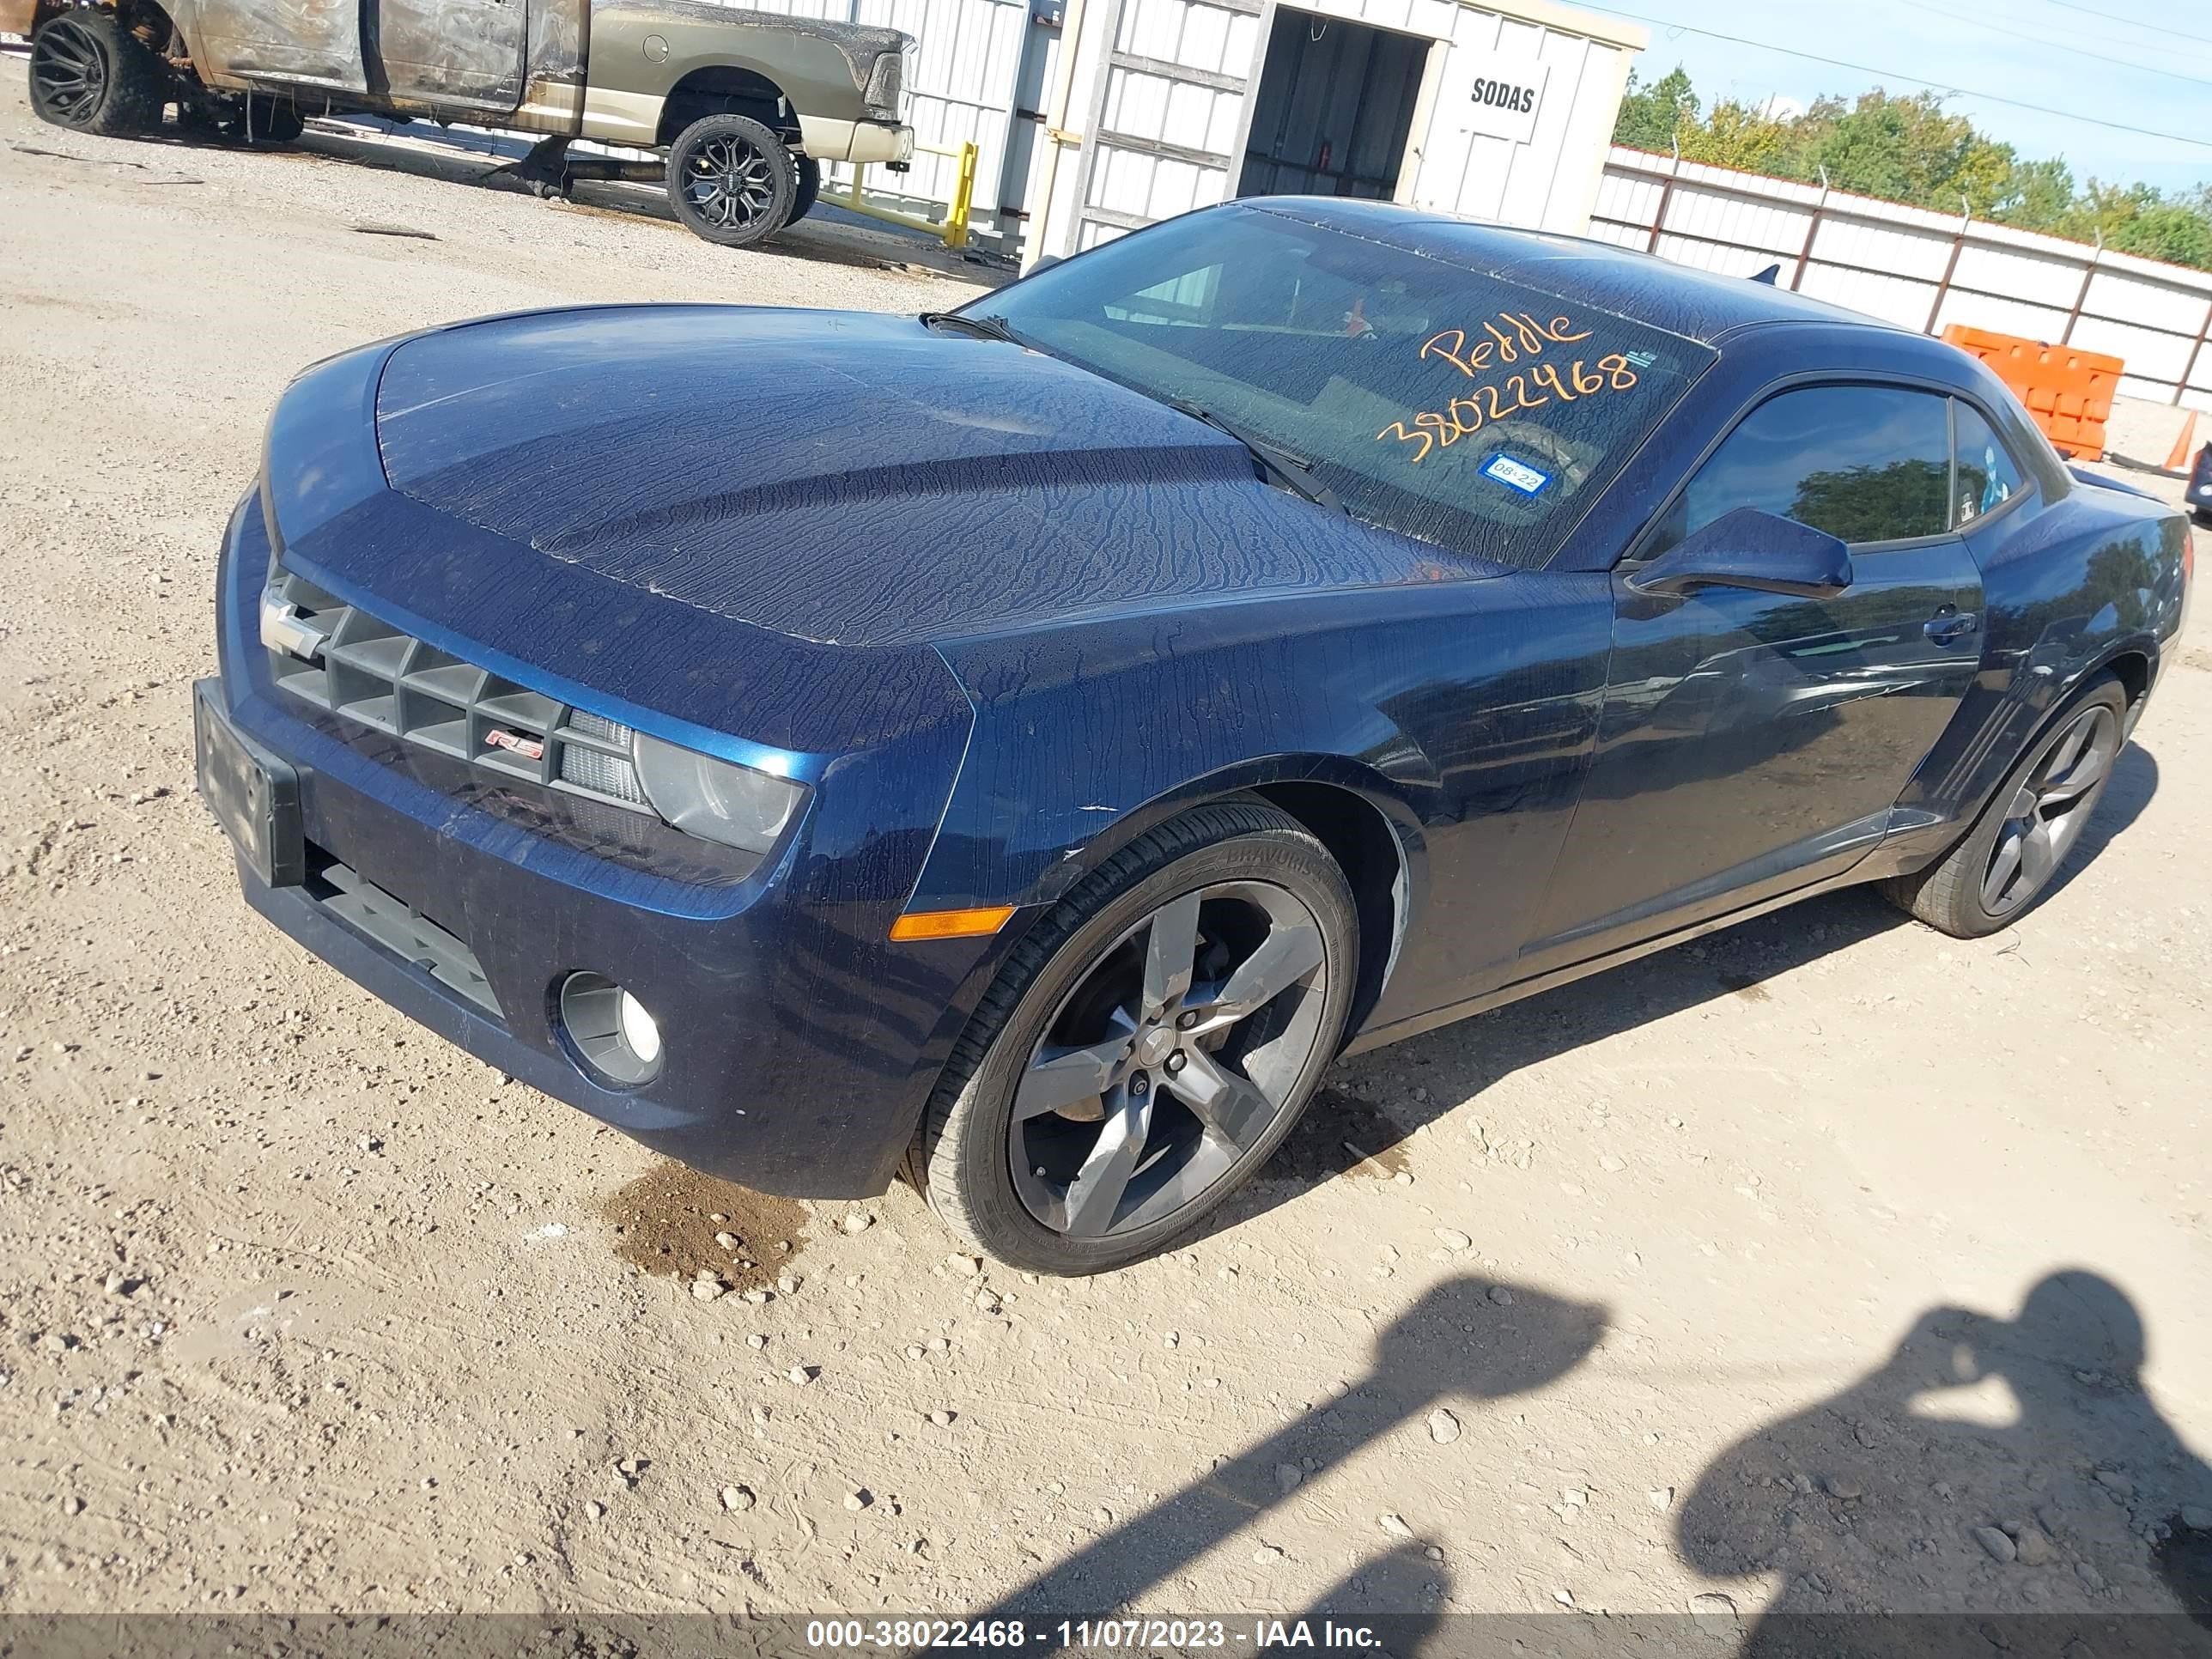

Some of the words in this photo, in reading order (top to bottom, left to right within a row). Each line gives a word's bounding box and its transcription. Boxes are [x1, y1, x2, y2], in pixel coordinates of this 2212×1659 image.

[1471, 77, 1534, 113] SODAS
[1376, 354, 1638, 462] 38022468
[485, 729, 544, 759] RS
